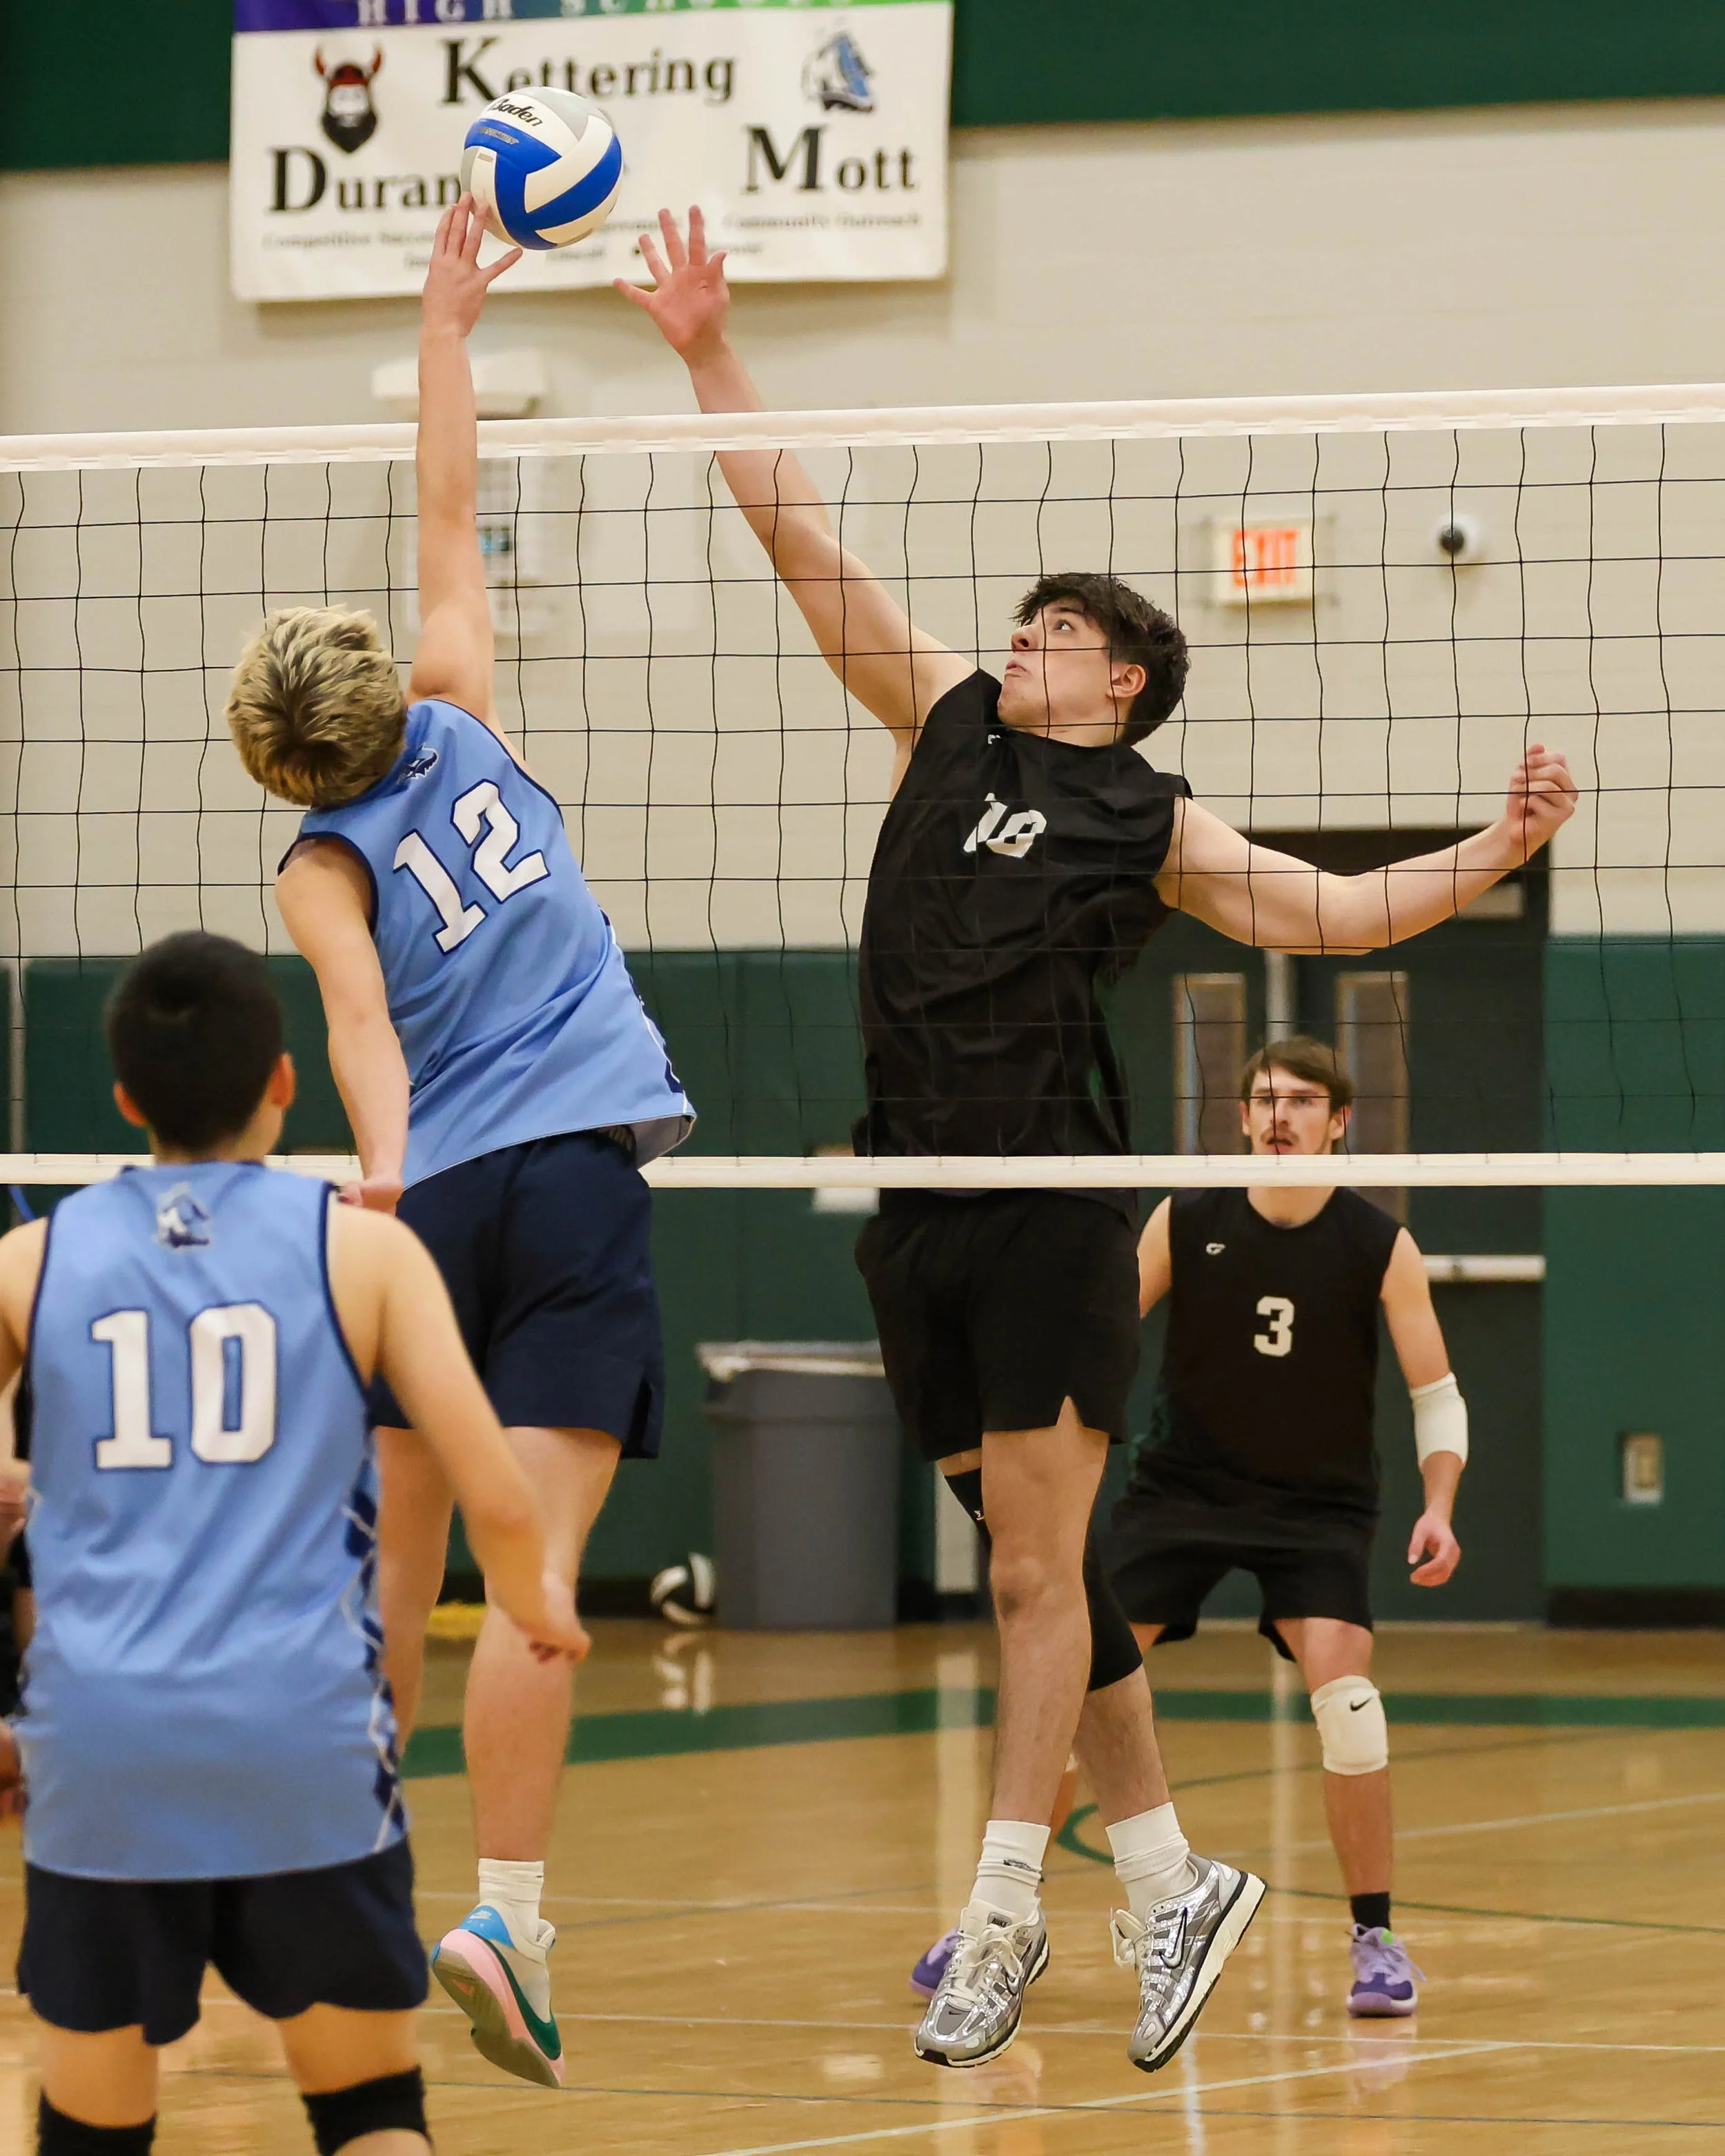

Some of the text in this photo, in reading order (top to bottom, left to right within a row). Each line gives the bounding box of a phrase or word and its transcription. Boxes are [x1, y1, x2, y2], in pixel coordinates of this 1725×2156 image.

[441, 35, 736, 103] Kettering
[489, 99, 543, 127] Baden
[269, 123, 918, 212] Duran Mott
[1233, 531, 1297, 586] EXIT
[393, 779, 551, 955] 12
[1254, 1296, 1294, 1357] 3
[90, 1302, 278, 1470] 10
